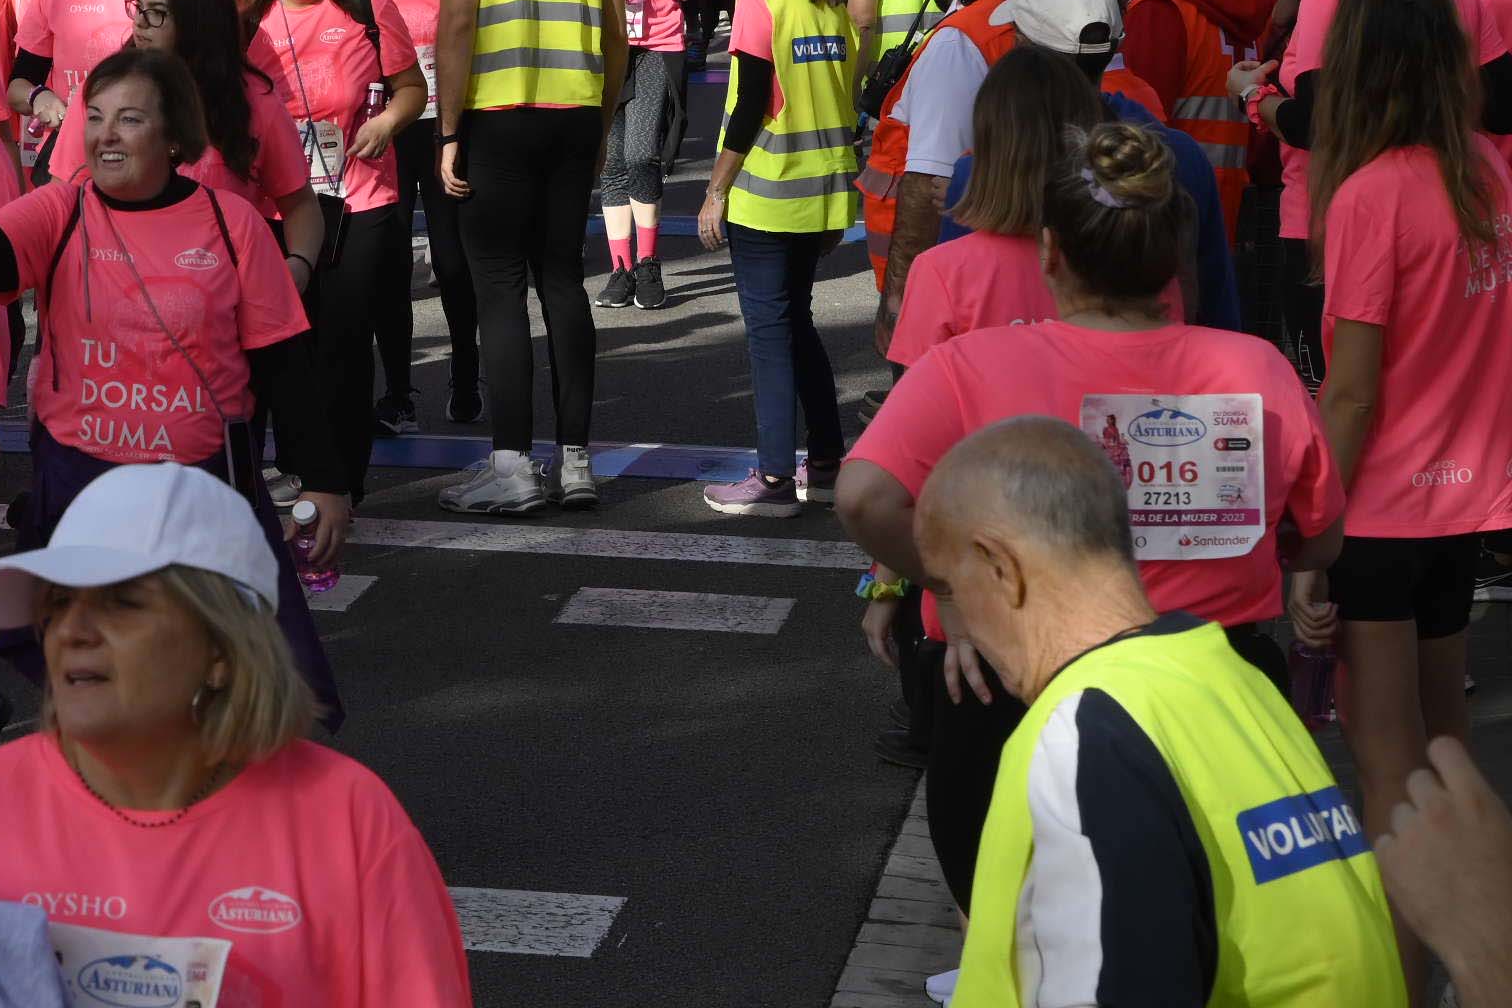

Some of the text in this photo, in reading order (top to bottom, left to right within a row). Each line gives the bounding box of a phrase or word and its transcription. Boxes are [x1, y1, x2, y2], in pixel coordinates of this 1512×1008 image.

[69, 3, 105, 14] OYSHO
[80, 338, 116, 369] TU
[80, 377, 207, 414] DORSAL
[1133, 424, 1201, 438] ASTURIANA
[1213, 416, 1249, 427] SUMA
[78, 414, 173, 452] SUMA
[1137, 460, 1199, 484] 016
[1412, 467, 1474, 489] OYSHO
[1143, 491, 1192, 506] 27213
[1148, 513, 1164, 523] DE
[1165, 514, 1179, 523] LA
[1181, 513, 1218, 523] MUJER
[1193, 534, 1252, 548] Santander
[21, 891, 128, 921] OYSHO
[215, 903, 296, 923] ASTURIANA
[86, 970, 179, 999] ASTURIANA
